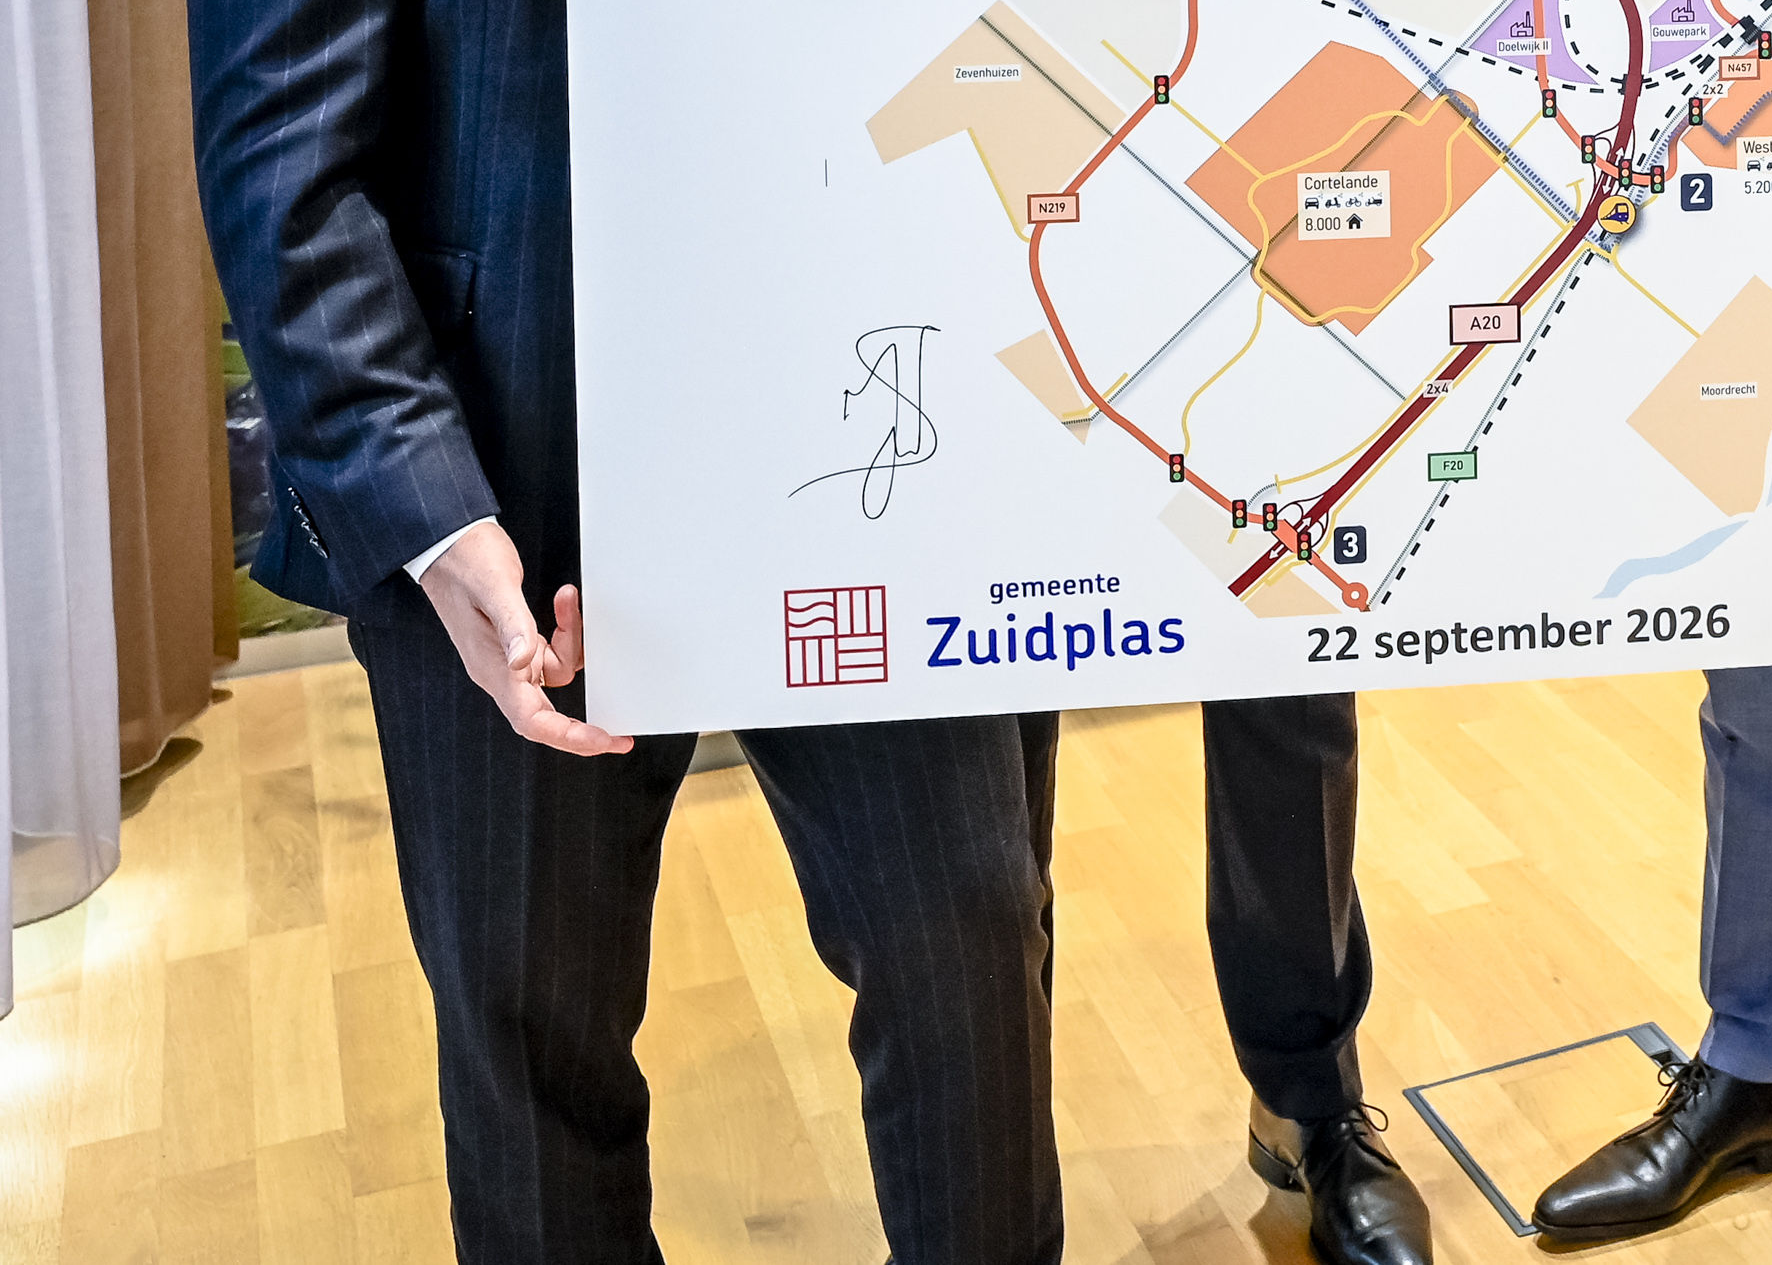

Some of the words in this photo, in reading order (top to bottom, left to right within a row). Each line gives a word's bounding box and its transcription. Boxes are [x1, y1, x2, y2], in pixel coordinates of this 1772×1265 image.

[1652, 24, 1708, 40] Gouwepark
[1497, 40, 1540, 53] Doelwijk
[1543, 40, 1549, 51] II
[955, 65, 1019, 79] Zevenhuizen
[1727, 62, 1752, 74] N457
[1702, 83, 1724, 97] 2x2
[1304, 175, 1379, 190] Cortelande
[1688, 176, 1706, 204] 2
[1038, 201, 1066, 214] N219
[1304, 215, 1342, 232] 8.000
[1469, 314, 1502, 331] A20
[1426, 382, 1449, 396] 2x4
[1701, 382, 1756, 398] Moordrecht
[1442, 459, 1464, 472] F20
[1341, 532, 1359, 559] 3
[988, 573, 1121, 605] gemeente
[926, 608, 1186, 672] Zuidplas
[1307, 626, 1359, 663] 22
[1374, 613, 1613, 664] september
[1626, 603, 1732, 644] 2026
